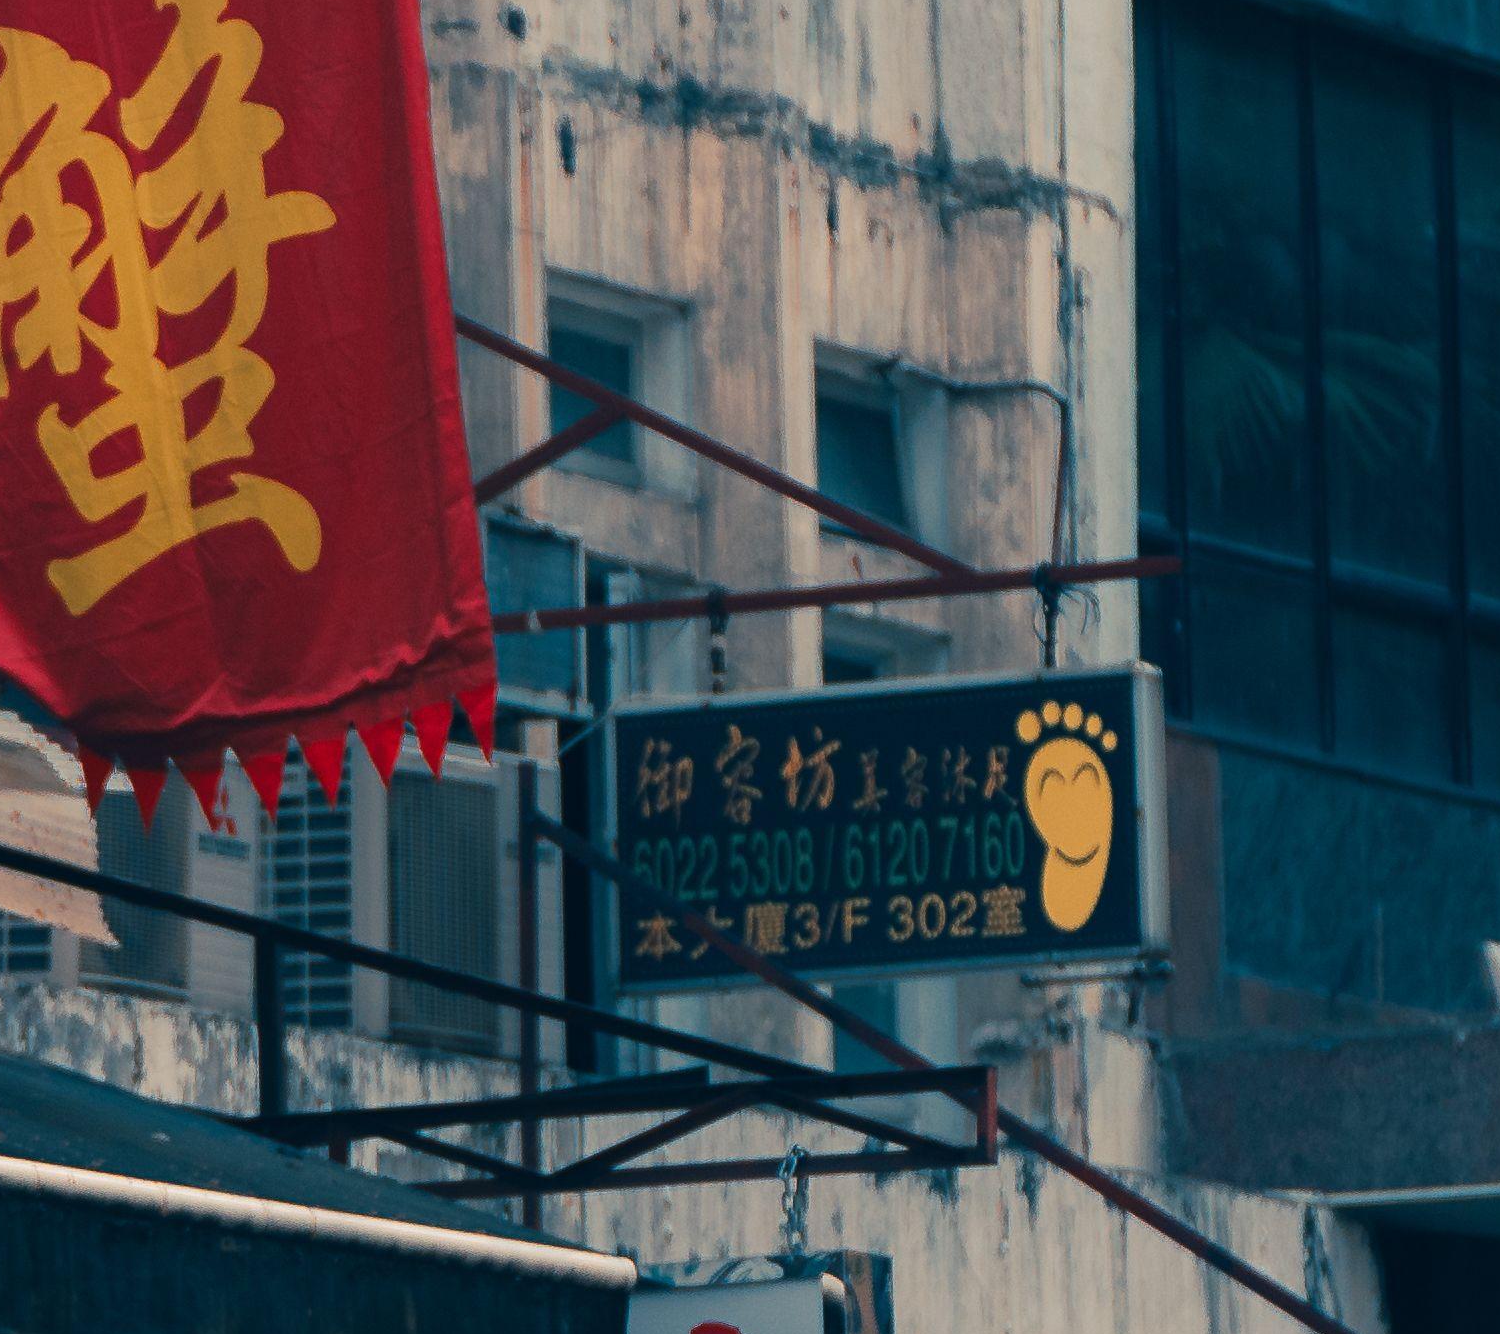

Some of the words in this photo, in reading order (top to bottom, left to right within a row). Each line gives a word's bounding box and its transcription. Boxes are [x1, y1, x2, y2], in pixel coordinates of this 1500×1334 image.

[632, 832, 720, 903] 6022
[842, 818, 931, 890] 6120
[938, 809, 1026, 883] 7160
